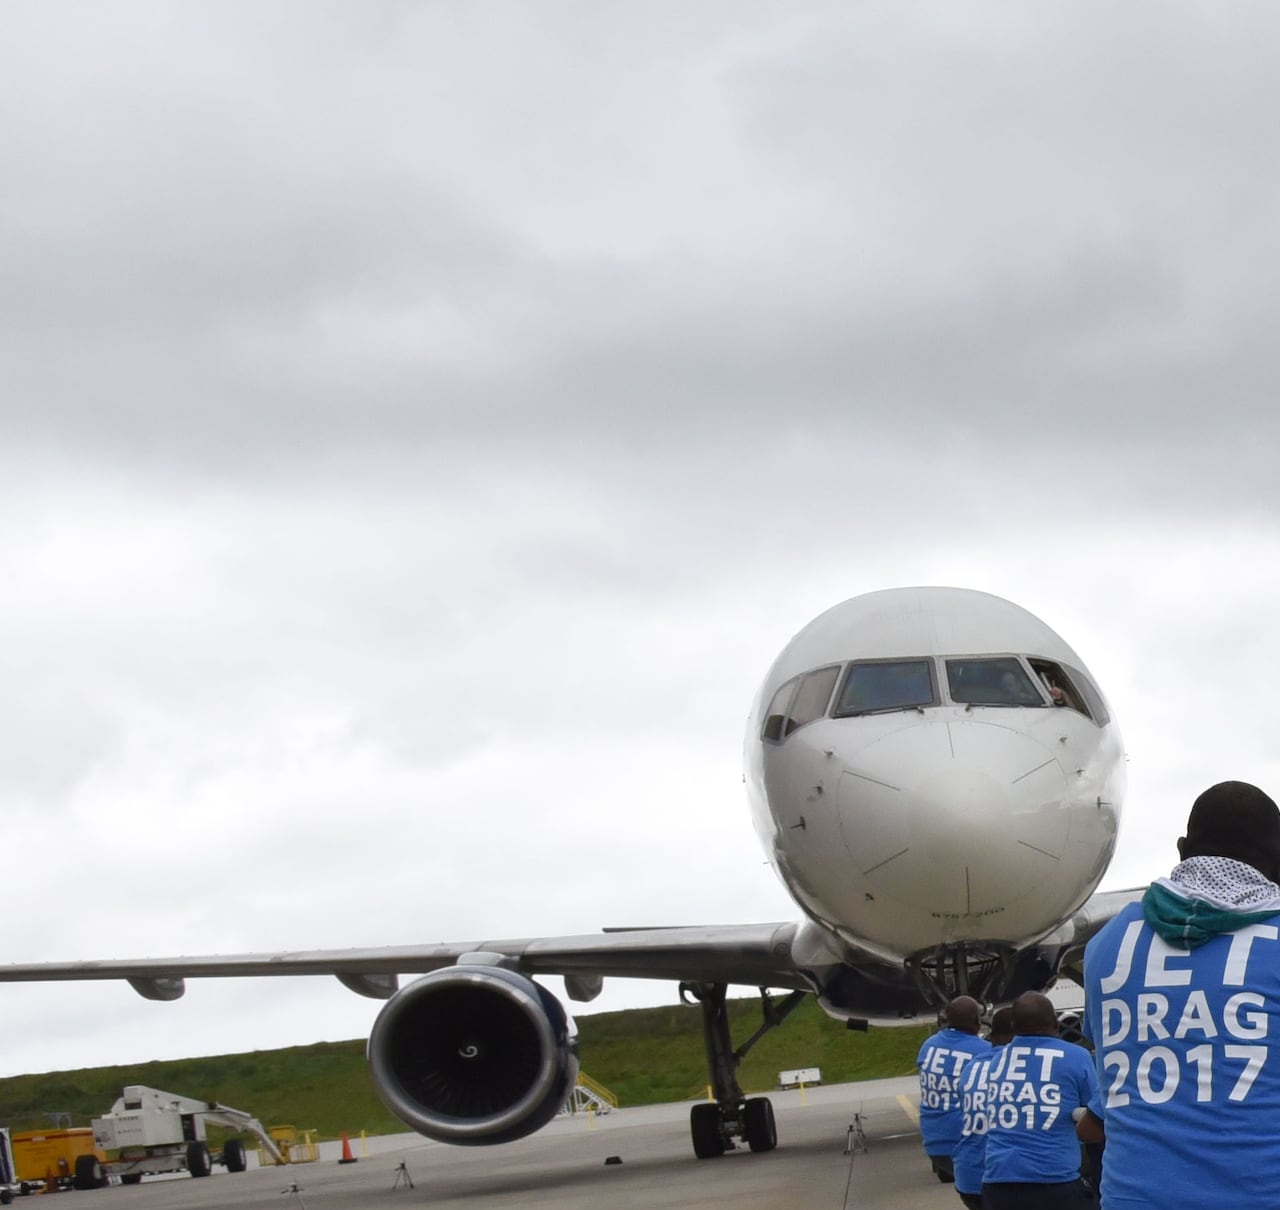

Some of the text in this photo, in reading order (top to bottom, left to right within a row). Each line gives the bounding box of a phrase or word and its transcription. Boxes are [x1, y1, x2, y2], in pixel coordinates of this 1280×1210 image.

[1101, 920, 1278, 994] JET
[1101, 990, 1268, 1047] DRAG
[922, 1046, 972, 1076] JET
[989, 1046, 1065, 1082] JET
[1103, 1044, 1268, 1109] 2017
[988, 1082, 1061, 1105] DRAG
[988, 1104, 1061, 1131] 2017
